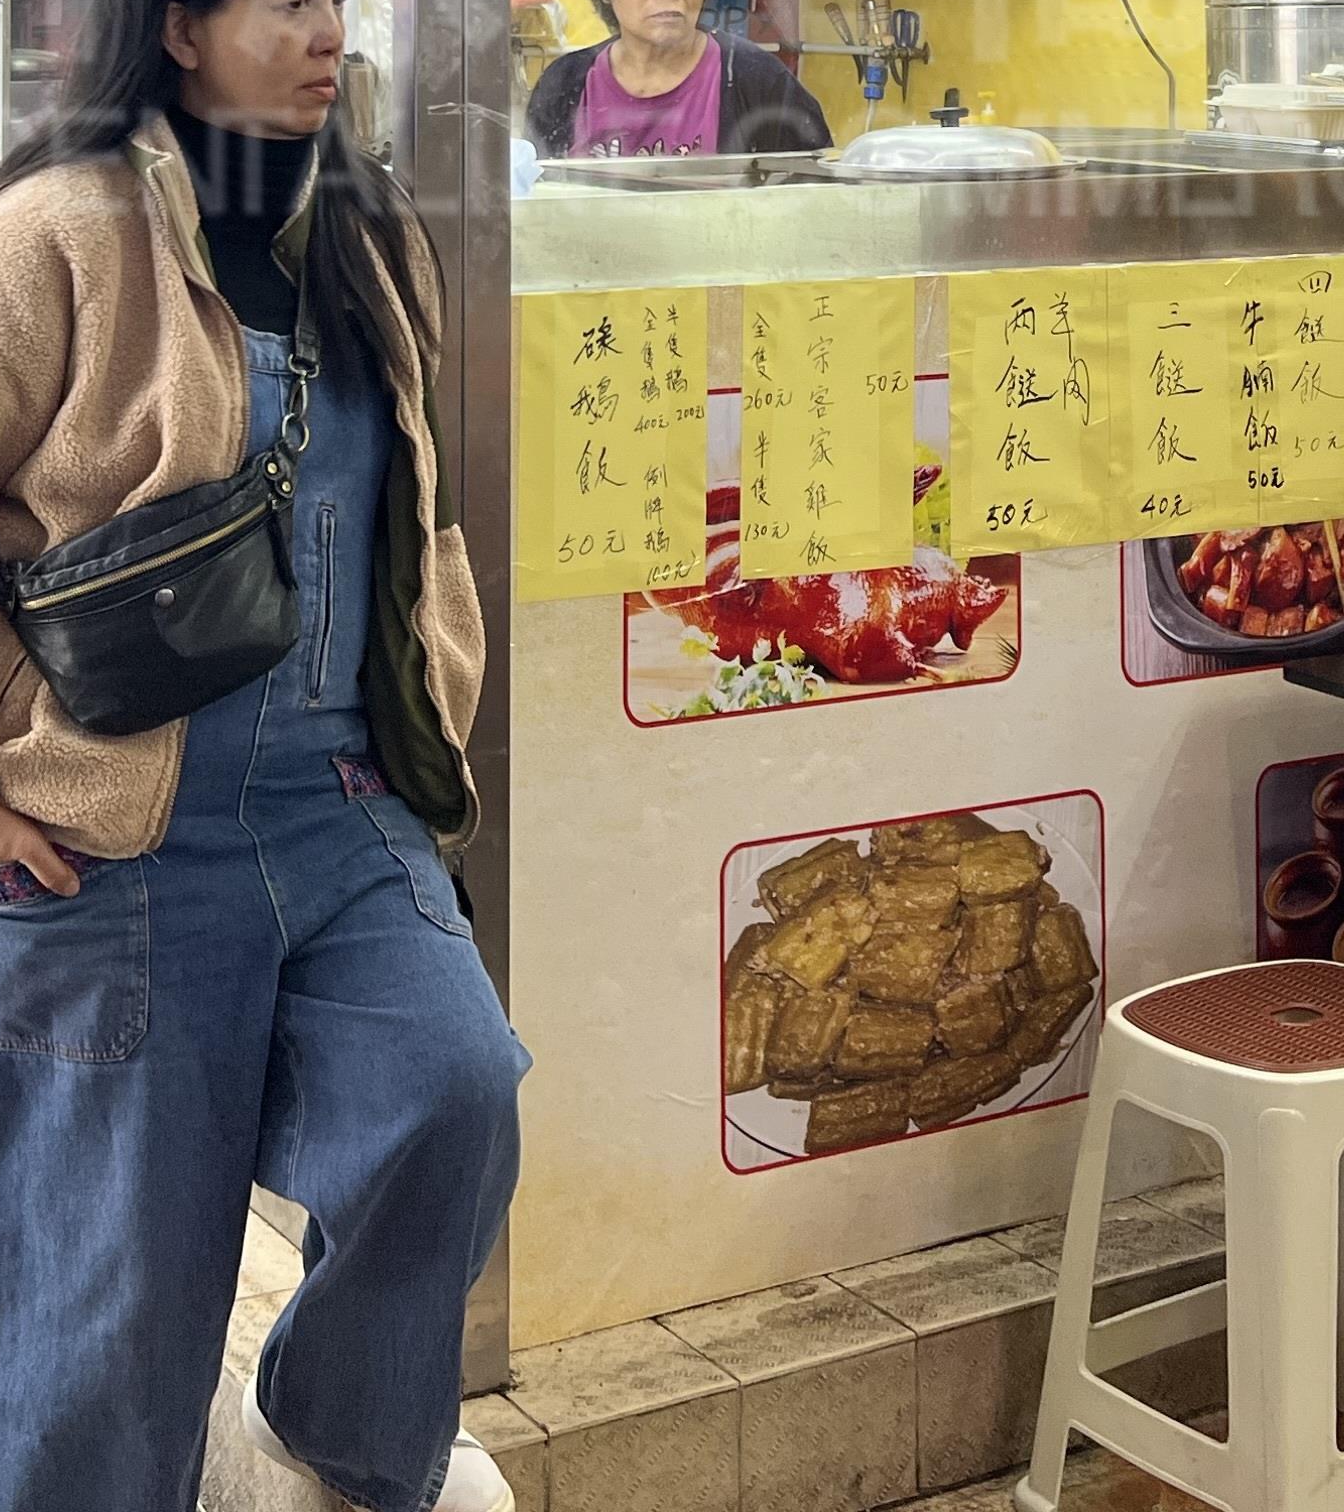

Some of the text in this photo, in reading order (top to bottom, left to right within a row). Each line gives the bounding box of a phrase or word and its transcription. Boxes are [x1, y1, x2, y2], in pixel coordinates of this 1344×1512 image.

[865, 369, 910, 396] 50元
[743, 388, 793, 411] 260元
[1140, 493, 1193, 520] 40元
